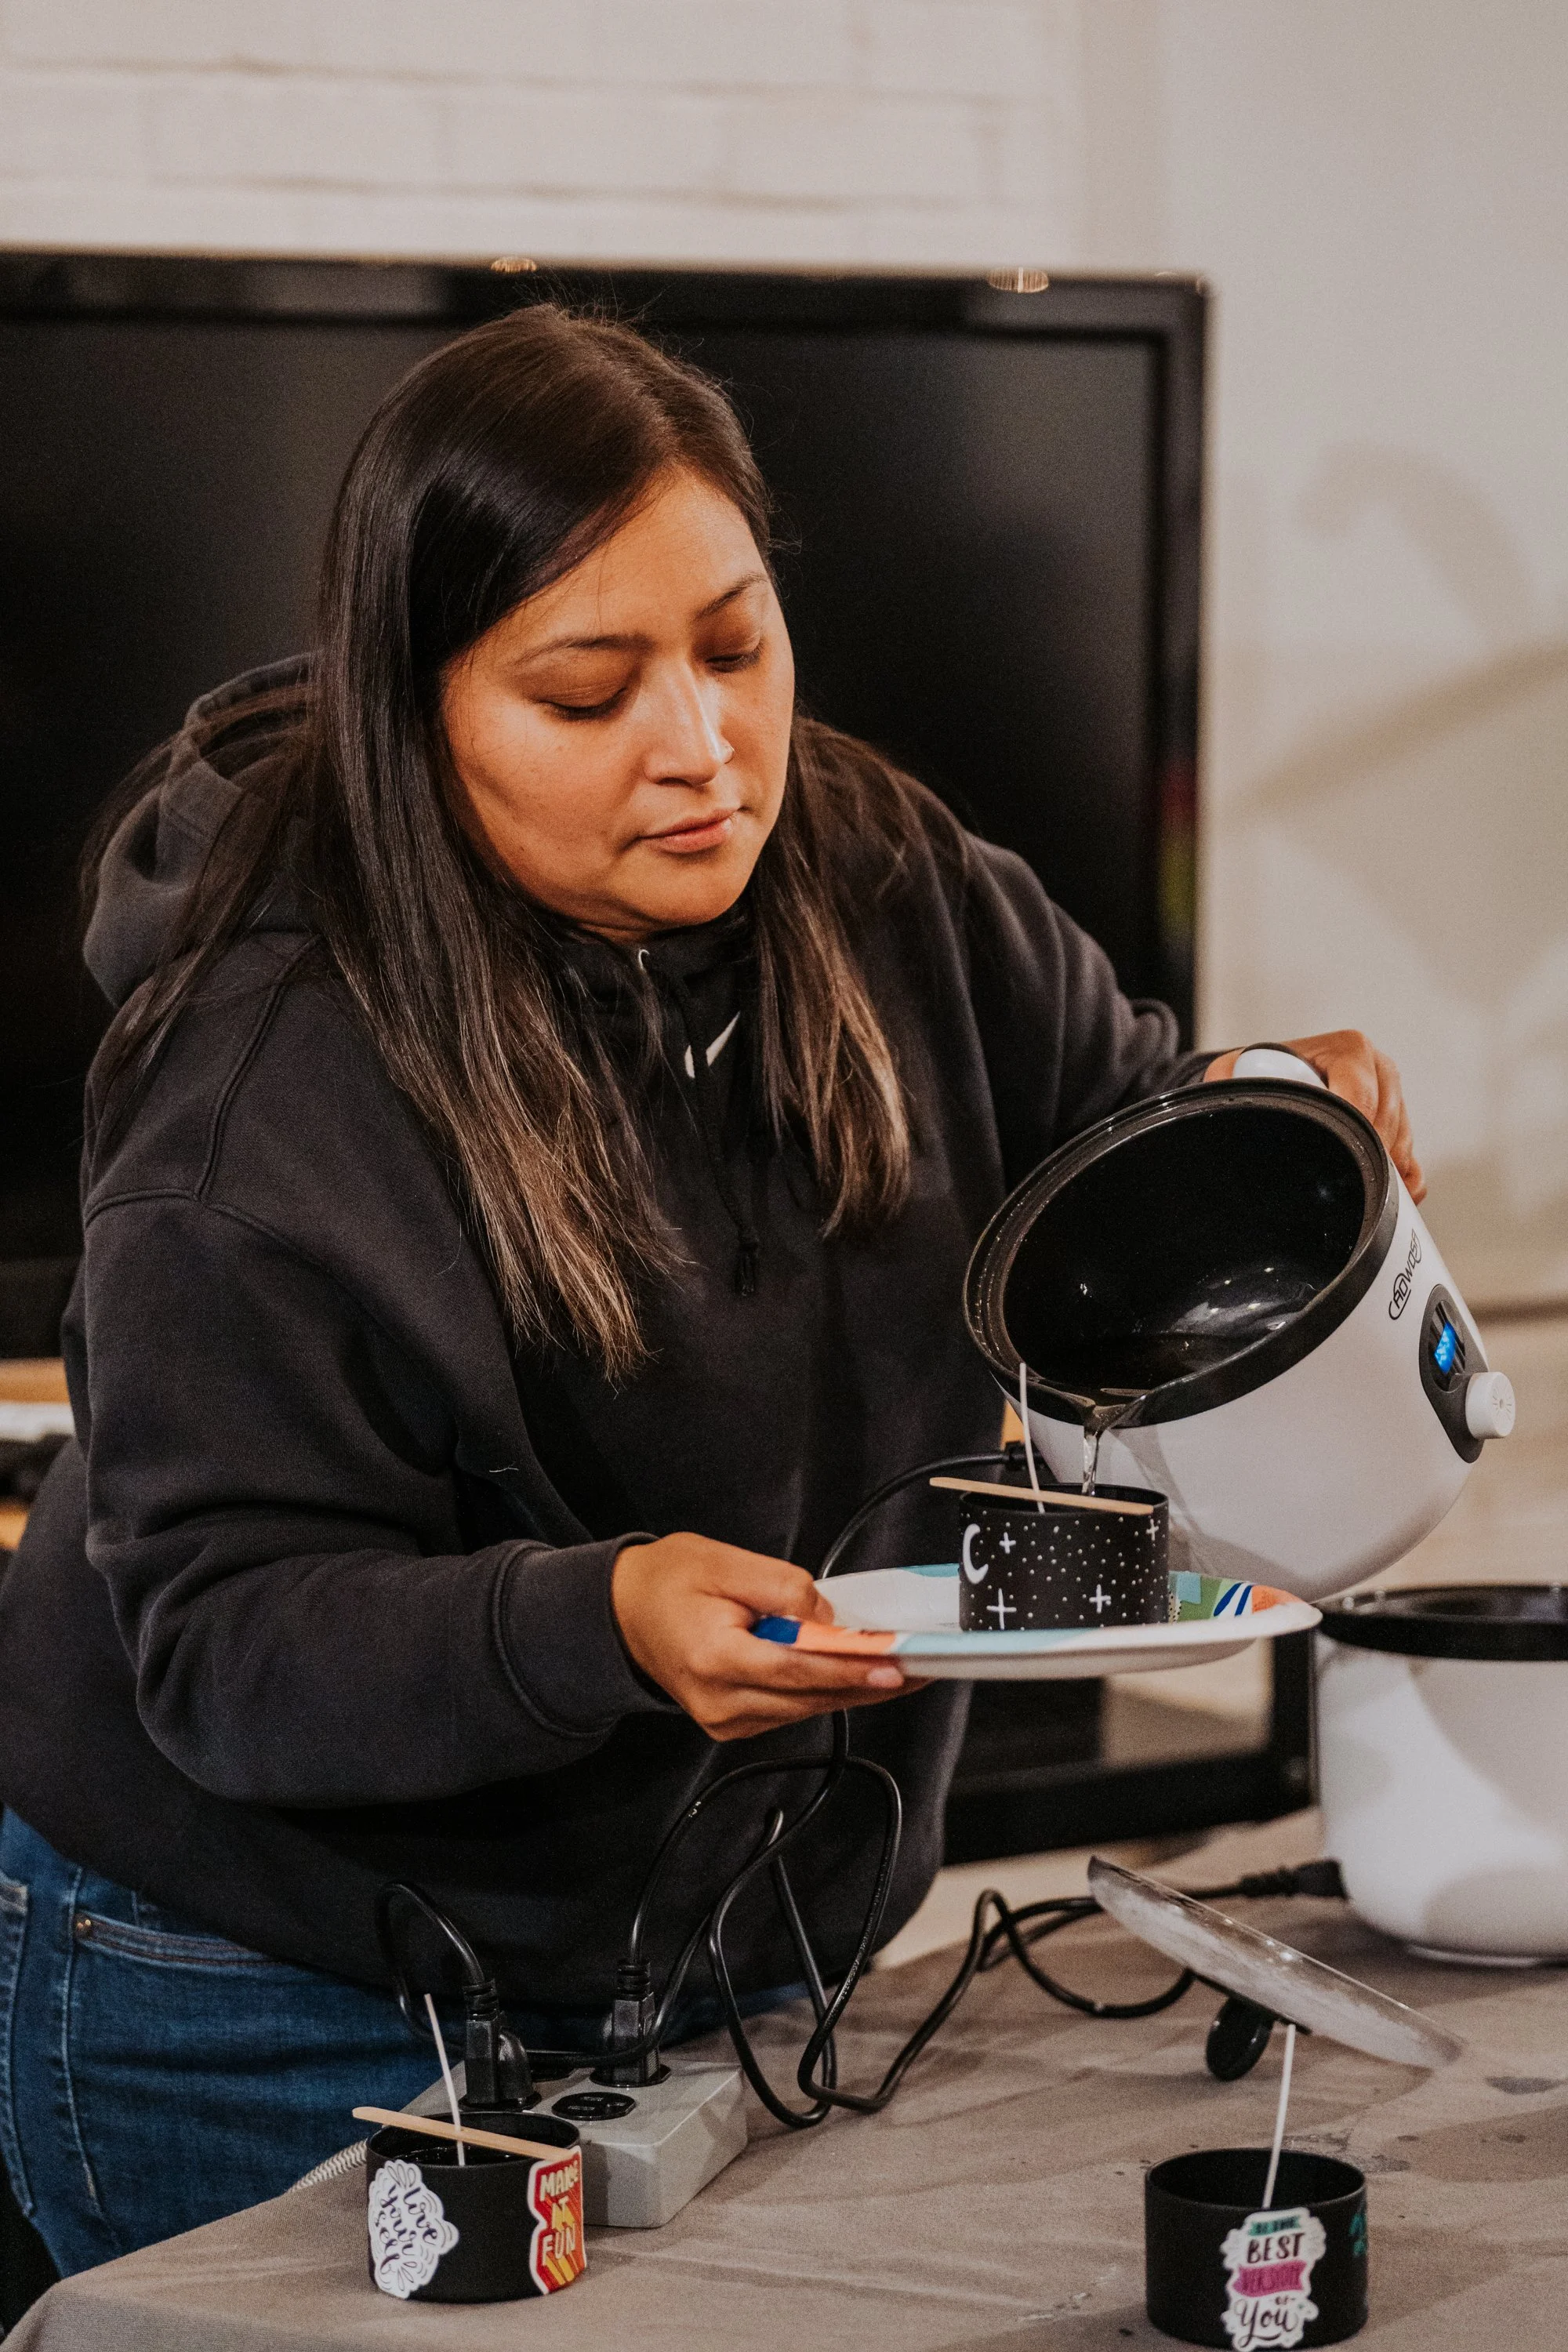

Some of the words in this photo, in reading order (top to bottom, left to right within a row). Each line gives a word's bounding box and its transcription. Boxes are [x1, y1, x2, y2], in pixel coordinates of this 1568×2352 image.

[375, 2210, 401, 2275] self
[379, 2184, 417, 2256] your
[403, 2187, 437, 2246] love
[542, 2223, 576, 2267] FUN
[1247, 2232, 1305, 2264] BEST
